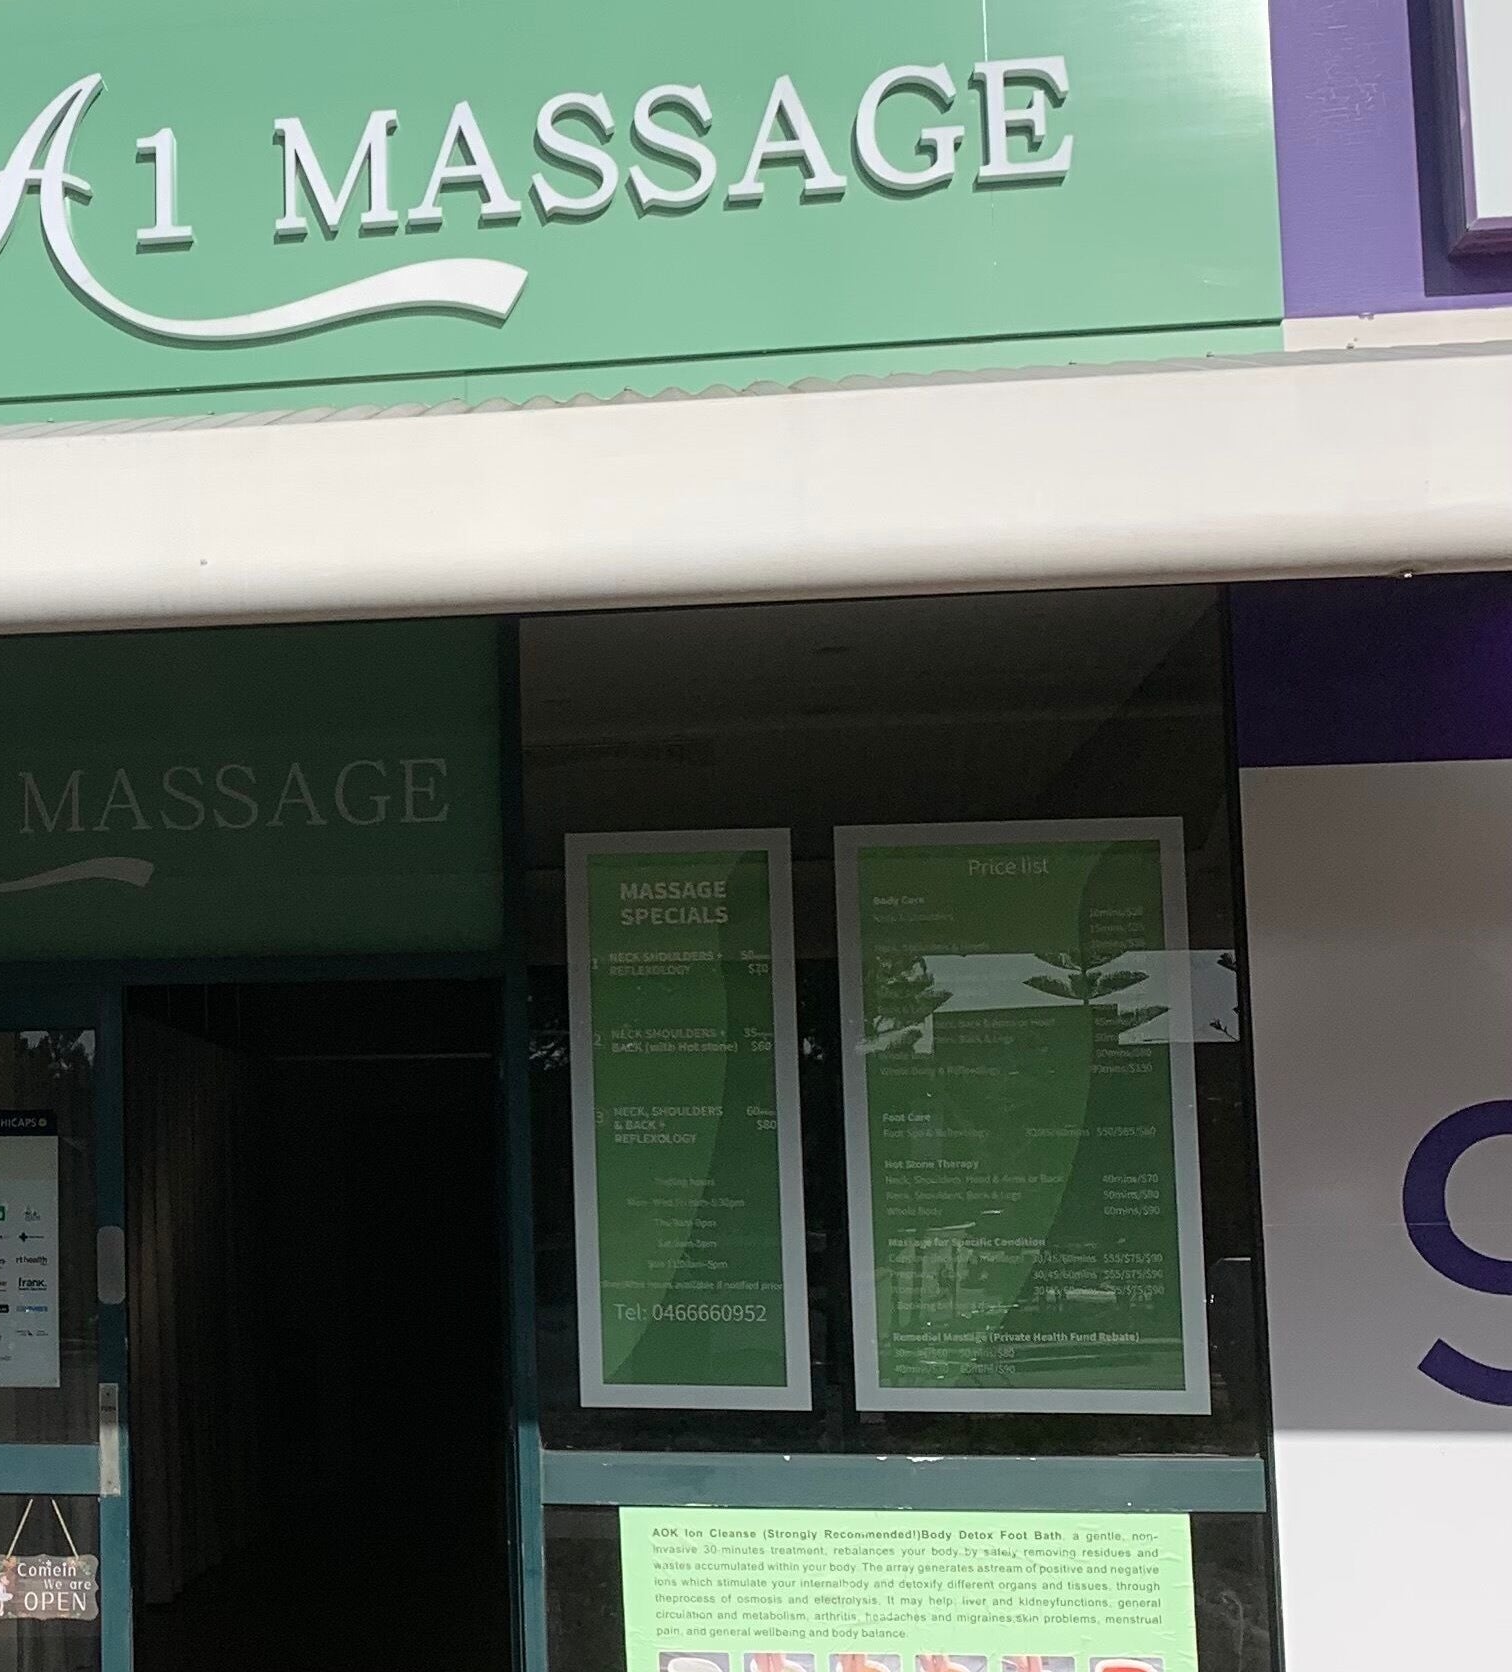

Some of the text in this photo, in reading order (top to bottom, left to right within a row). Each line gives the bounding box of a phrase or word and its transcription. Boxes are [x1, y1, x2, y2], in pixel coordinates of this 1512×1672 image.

[273, 55, 1076, 240] MASSAGE
[19, 757, 450, 834] MASSAGE
[969, 857, 1050, 875] Price list
[621, 881, 727, 900] MASSAGE
[621, 906, 728, 925] SPECIALS
[643, 951, 713, 961] SHOULDERS
[646, 1028, 717, 1038] SHOULDERS
[652, 1106, 723, 1117] SHOULDERS
[883, 1113, 931, 1122] Foot Care
[0, 1118, 37, 1127] HICAPS
[626, 1120, 656, 1130] BACK
[615, 1133, 697, 1144] REFLEXOLOGY
[885, 1160, 903, 1169] Hot
[938, 1159, 978, 1170] Therapy
[994, 1237, 1046, 1247] Condition
[613, 1303, 767, 1322] Tel: 0466660952
[893, 1332, 941, 1341] Remedial
[990, 1331, 1031, 1343] (Private
[1033, 1331, 1068, 1342] Health
[1070, 1332, 1096, 1341] Fund
[1098, 1331, 1141, 1343] Rebate)
[652, 1529, 678, 1538] AOK
[685, 1529, 703, 1538] Ion
[709, 1529, 756, 1538] Cleanse
[763, 1529, 817, 1540] (Strongly
[959, 1530, 993, 1540] Detox
[1000, 1531, 1028, 1540] Foot
[1132, 1533, 1158, 1541] non-
[833, 1546, 895, 1556] rebalances
[901, 1549, 925, 1558] your
[1024, 1548, 1076, 1558] removing
[1082, 1548, 1131, 1557] residues
[1137, 1549, 1158, 1557] and
[654, 1562, 691, 1571] wastes
[695, 1562, 764, 1571] accumulated
[767, 1562, 799, 1571] within
[803, 1564, 826, 1573] your
[862, 1562, 883, 1572] The
[886, 1564, 917, 1574] array
[918, 1564, 973, 1574] generates
[977, 1565, 1023, 1573] astream
[1025, 1564, 1037, 1573] of
[1039, 1564, 1083, 1575] positive
[1086, 1565, 1107, 1574] and
[1110, 1565, 1159, 1576] negative
[43, 1579, 91, 1590] We are
[654, 1578, 677, 1587] ions
[681, 1578, 712, 1587] which
[717, 1578, 767, 1587] stimulate
[772, 1580, 795, 1589] your
[874, 1580, 894, 1588] and
[899, 1579, 943, 1591] detoxify
[947, 1580, 994, 1590] different
[999, 1582, 1037, 1592] organs
[1042, 1581, 1062, 1590] and
[1116, 1581, 1160, 1592] through
[24, 1591, 86, 1611] OPEN
[655, 1594, 715, 1605] theprocess
[721, 1594, 731, 1603] of
[737, 1595, 782, 1604] osmosis
[788, 1595, 808, 1604] and
[887, 1595, 894, 1604] It
[900, 1598, 922, 1607] may
[962, 1596, 986, 1606] liver
[993, 1597, 1012, 1606] and
[1118, 1598, 1161, 1609] general
[656, 1610, 712, 1620] circulation
[717, 1611, 737, 1620] and
[865, 1612, 926, 1623] headaches
[931, 1613, 951, 1622] and
[1105, 1615, 1162, 1624] menstrual
[686, 1627, 706, 1636] and
[710, 1627, 751, 1638] general
[754, 1627, 805, 1639] wellbeing
[809, 1628, 829, 1637] and
[832, 1628, 858, 1639] body
